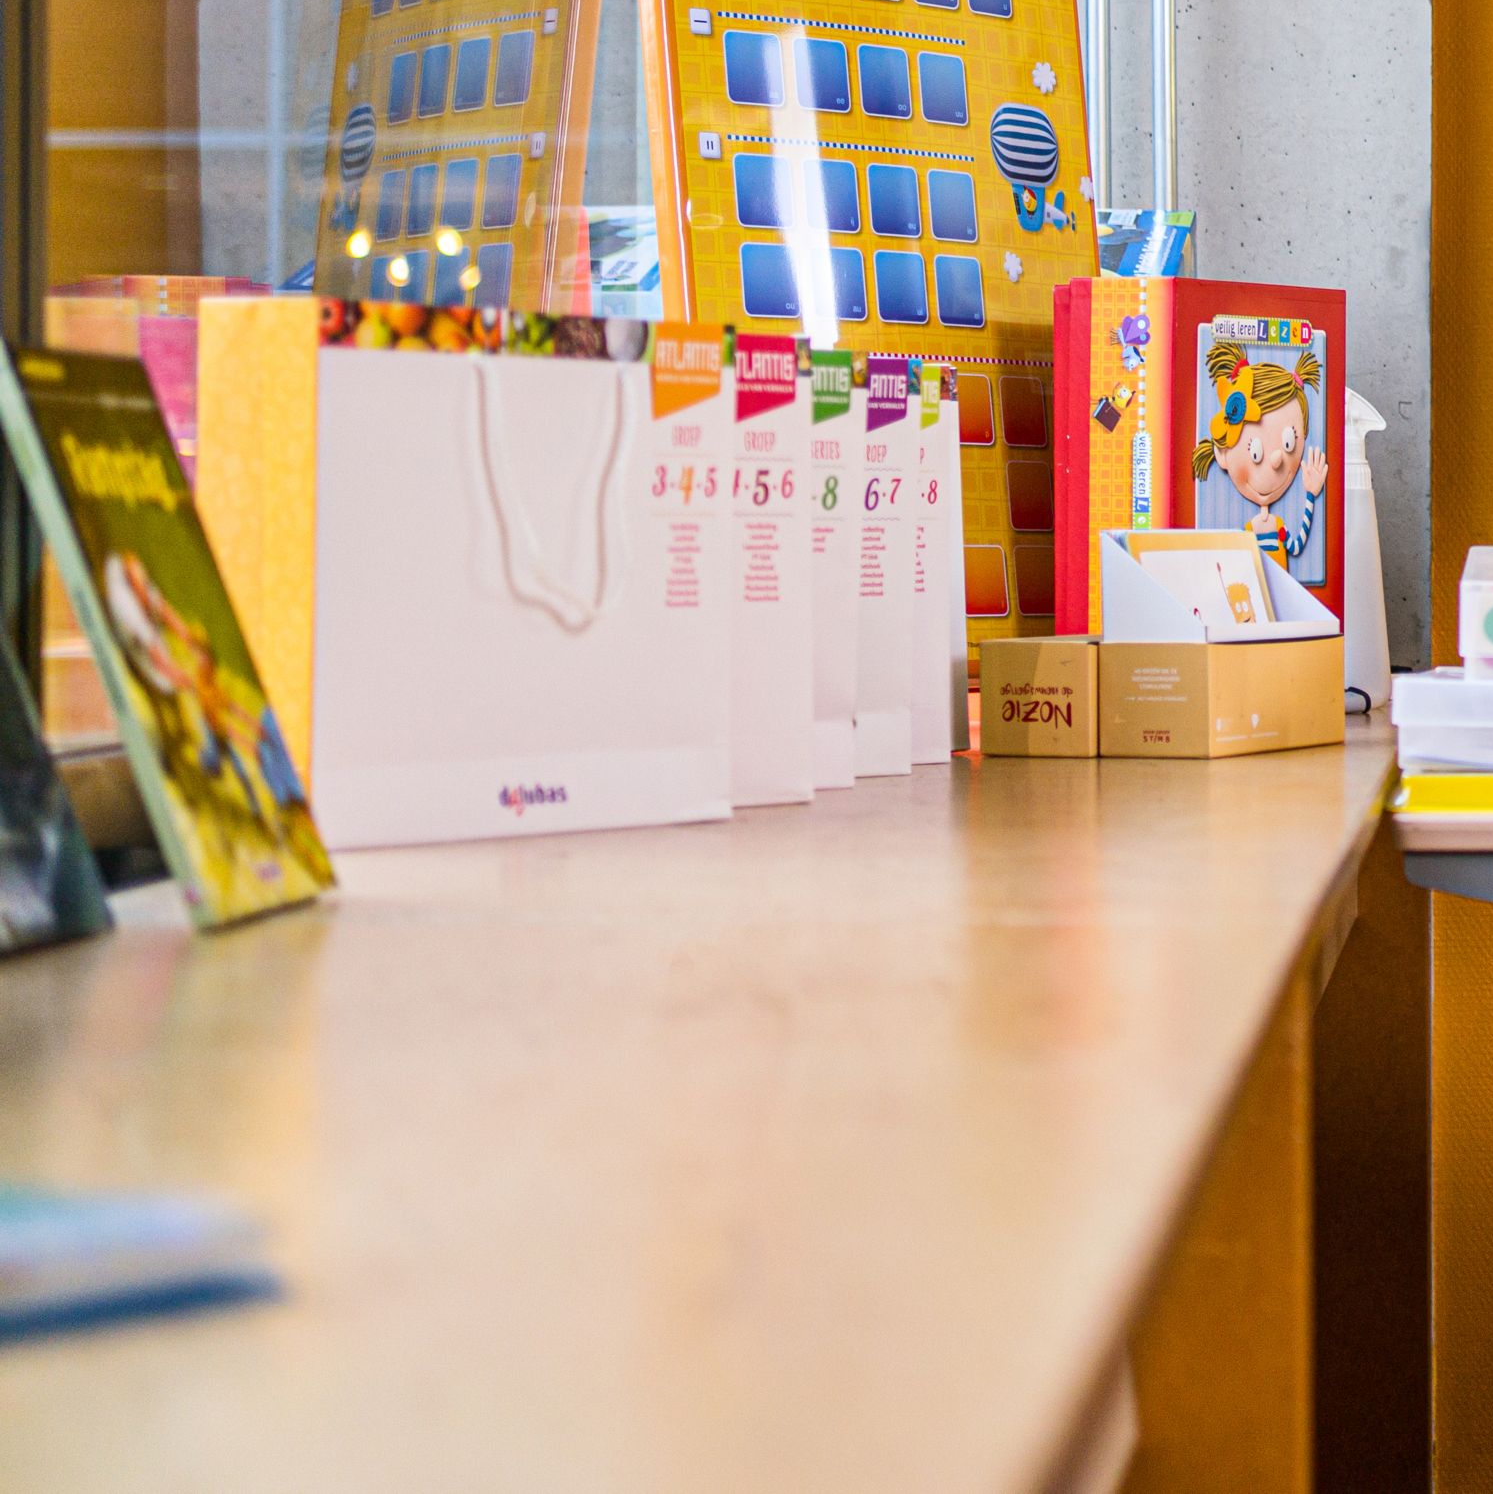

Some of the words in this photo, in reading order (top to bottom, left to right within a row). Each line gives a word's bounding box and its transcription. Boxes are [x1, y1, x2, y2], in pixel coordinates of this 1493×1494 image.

[1214, 320, 1236, 338] veilig
[1237, 321, 1257, 336] leren
[1258, 321, 1310, 340] Lezen
[870, 374, 907, 399] ANTIS
[744, 431, 776, 452] GROEP
[1136, 436, 1149, 466] veilig
[1138, 468, 1149, 495] leren
